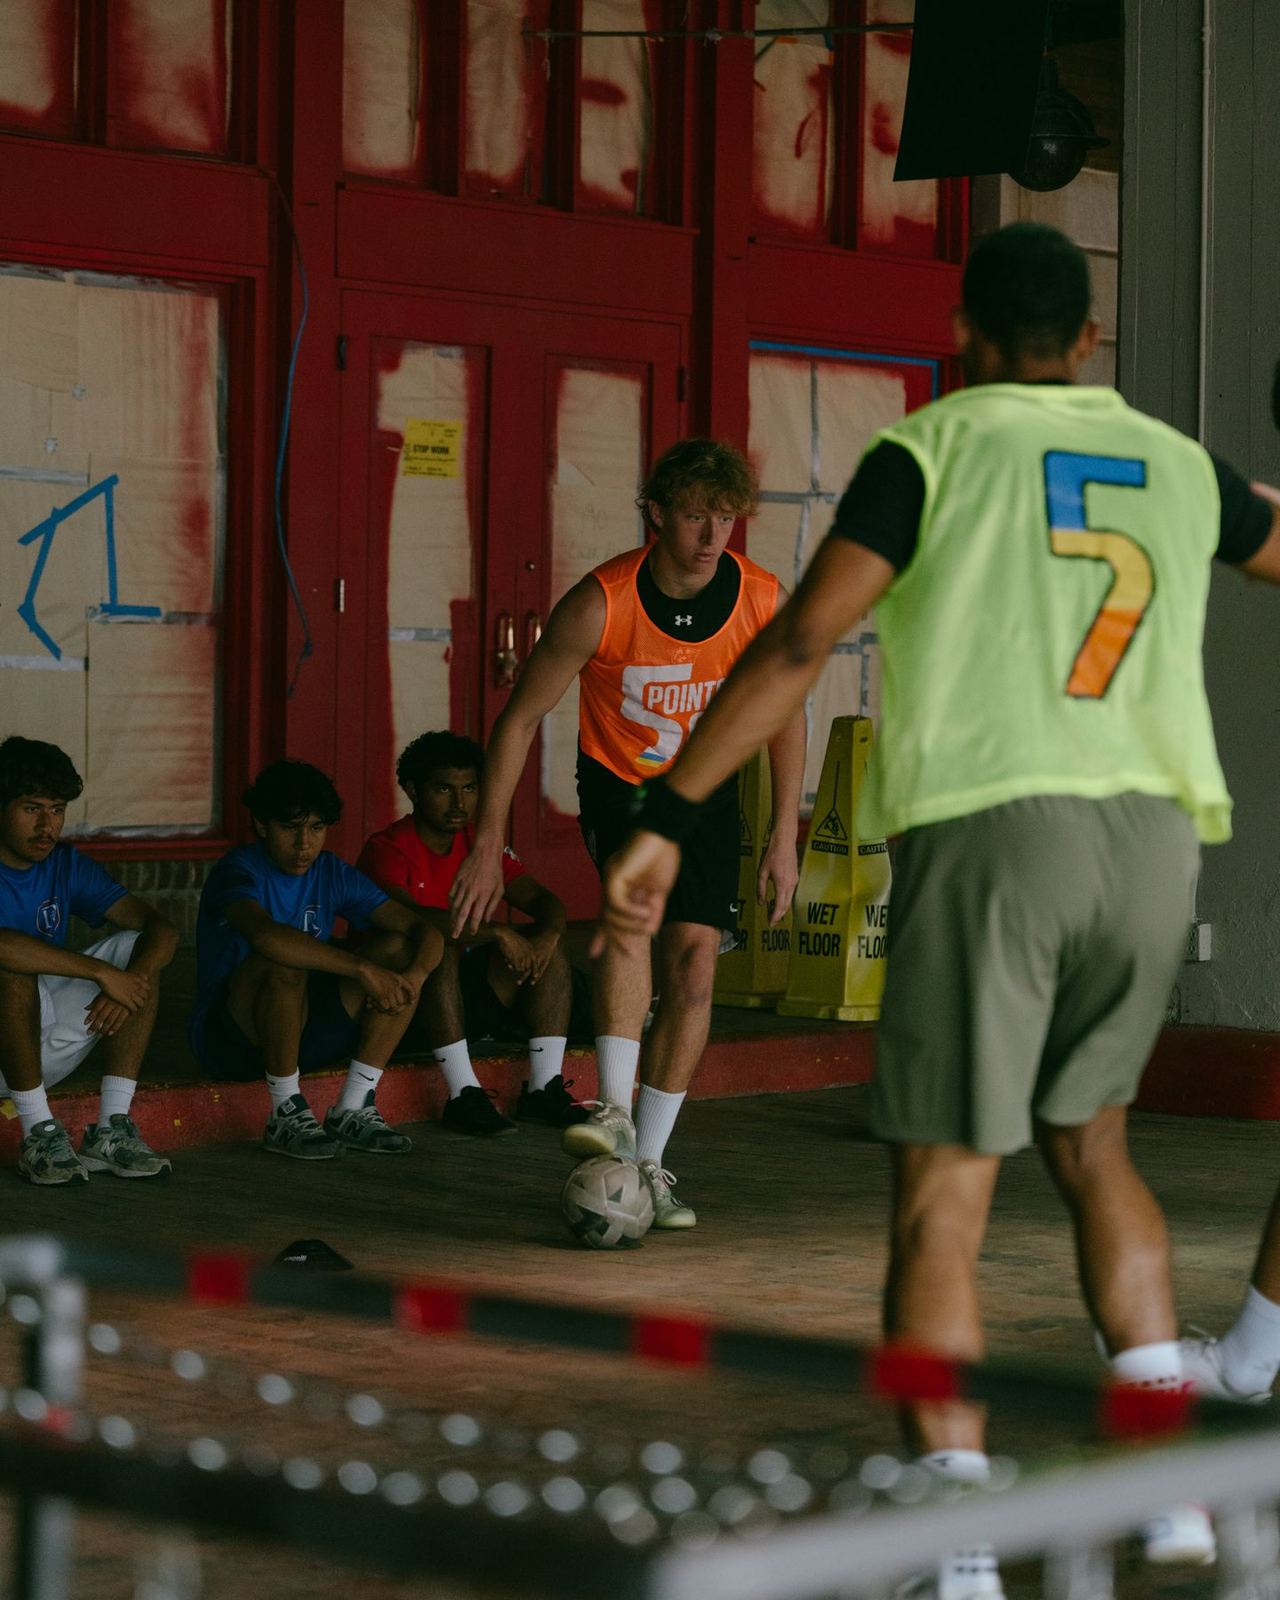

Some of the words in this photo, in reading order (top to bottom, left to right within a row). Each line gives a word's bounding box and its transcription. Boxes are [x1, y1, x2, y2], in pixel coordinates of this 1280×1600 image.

[1044, 451, 1155, 699] 5
[620, 663, 694, 768] 5
[808, 902, 840, 926] WET
[865, 905, 888, 928] WE
[762, 929, 790, 952] FLOOR
[799, 931, 841, 957] FLOOR
[857, 935, 888, 959] FLOO
